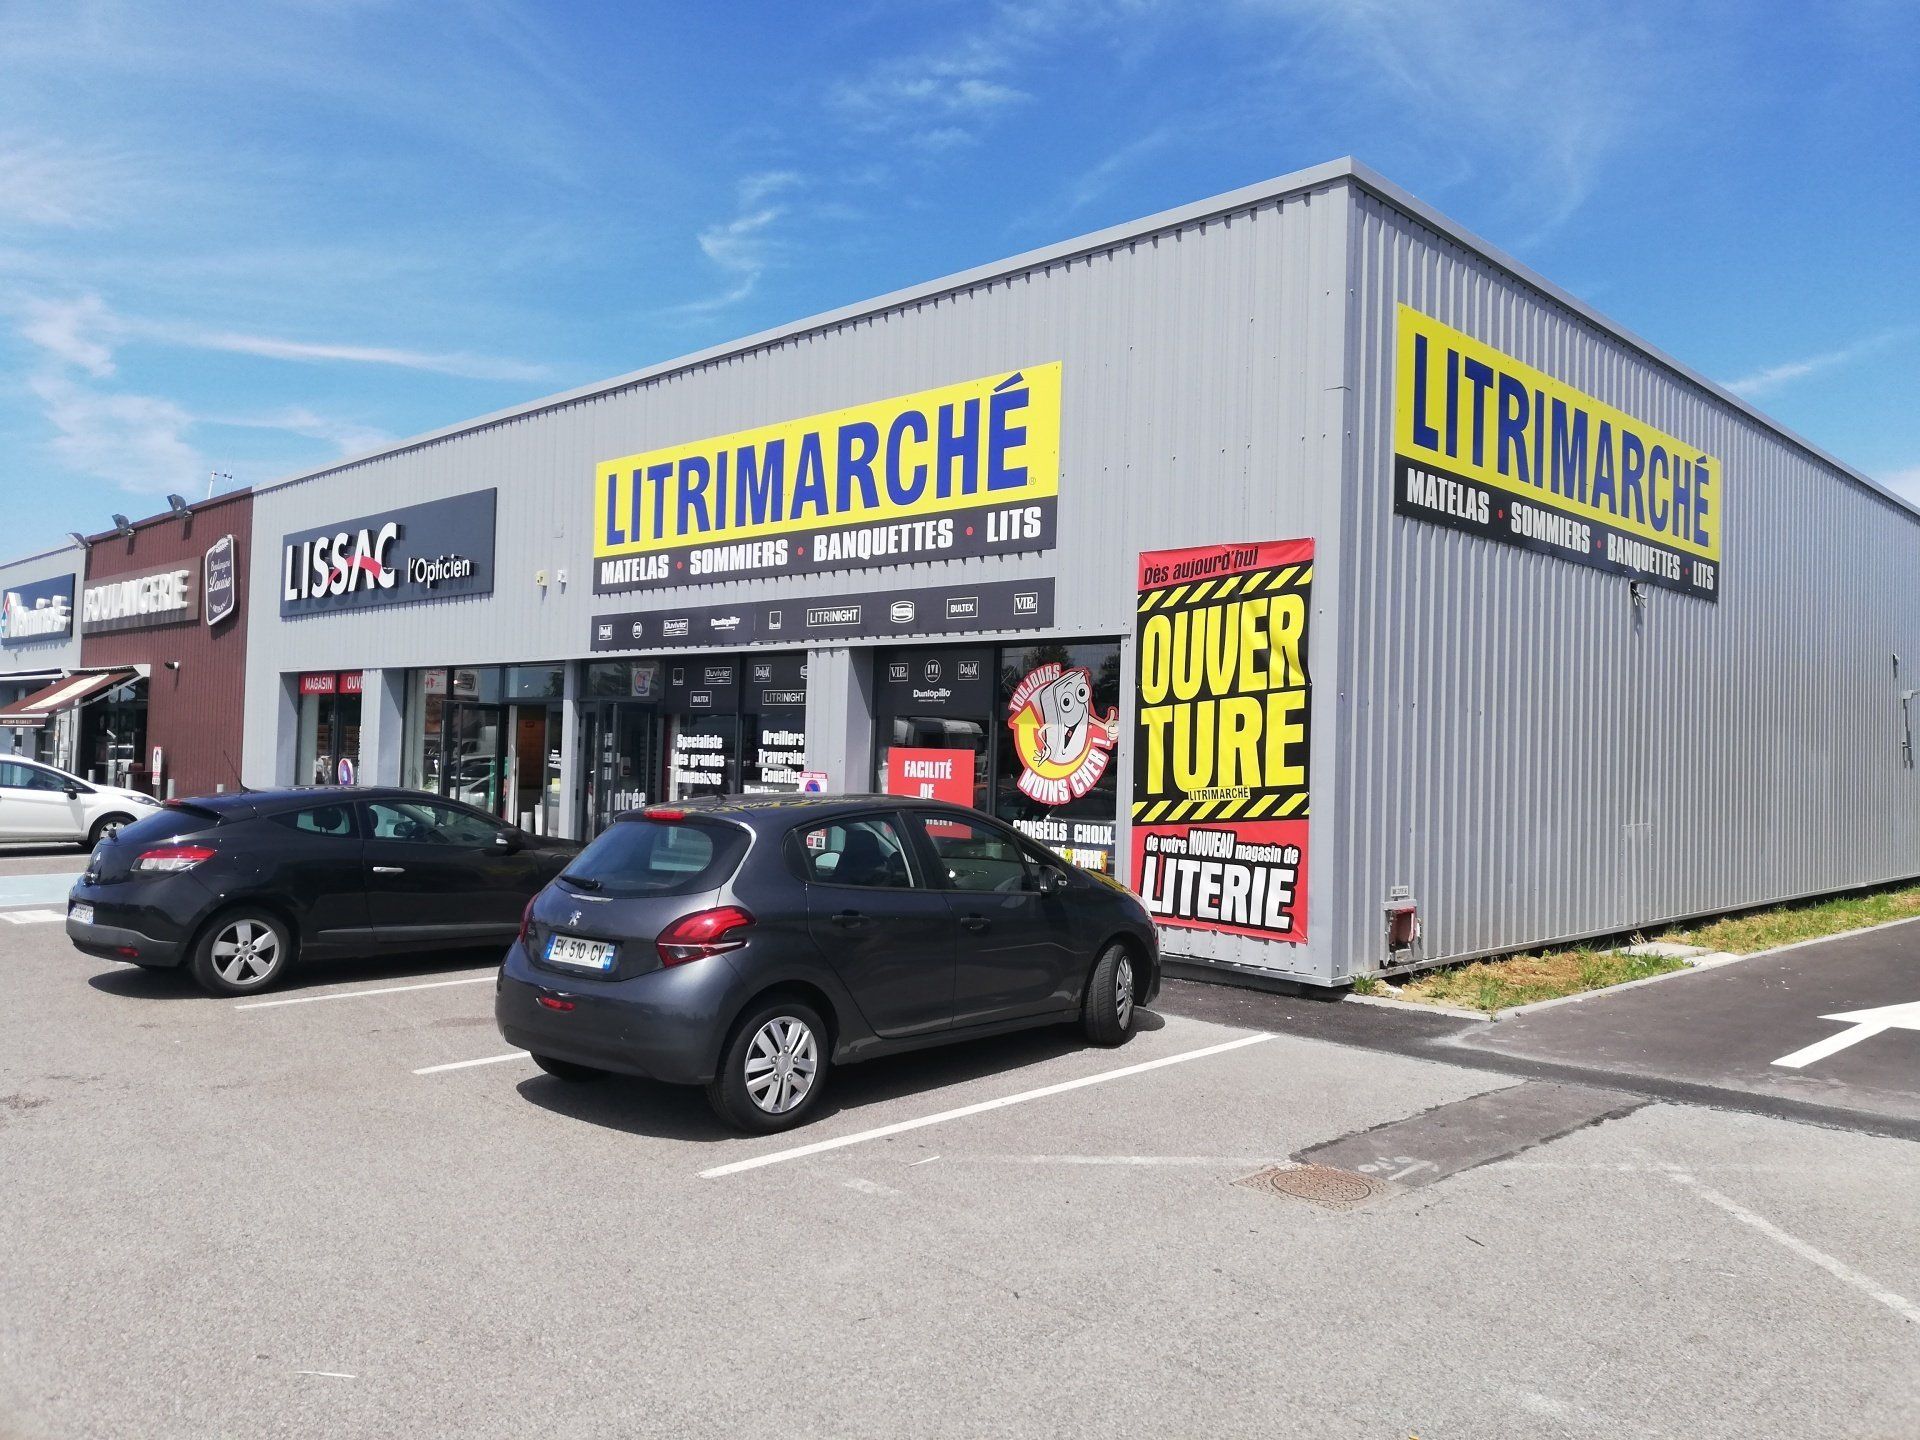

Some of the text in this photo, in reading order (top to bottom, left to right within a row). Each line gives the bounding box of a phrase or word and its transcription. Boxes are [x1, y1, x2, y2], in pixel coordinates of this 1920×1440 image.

[606, 372, 1030, 546] LITRIMARCHÉ
[1413, 333, 1709, 547] LITRIMARCHÉ
[601, 506, 1041, 585] MATELAS SOMMIERS BANQUETTES LITS
[1407, 468, 1714, 590] MATELAS SOMMIERS BANQUETTES LITS
[285, 522, 398, 601] LISSAC
[407, 553, 470, 588] l'Opticien
[1144, 546, 1259, 585] Dès aujourd'hui
[83, 570, 190, 622] BOULANGERIE
[950, 603, 974, 613] BULTEX
[1142, 593, 1306, 704] OUVER
[305, 677, 332, 690] MAGASIN
[913, 688, 950, 699] Dunlopillo
[1008, 664, 1061, 712] TOUJOURS
[762, 730, 804, 745] Oreillers
[1140, 690, 1306, 795] TURE
[690, 753, 725, 768] grandes
[904, 759, 952, 779] FACILITÉ
[1019, 769, 1069, 802] MOINS
[1070, 749, 1107, 795] CHER
[920, 783, 934, 799] DE
[1074, 824, 1112, 845] CHOIX
[1146, 830, 1299, 865] de votre NOUVEAU magasin de
[1142, 856, 1295, 929] LITERIE
